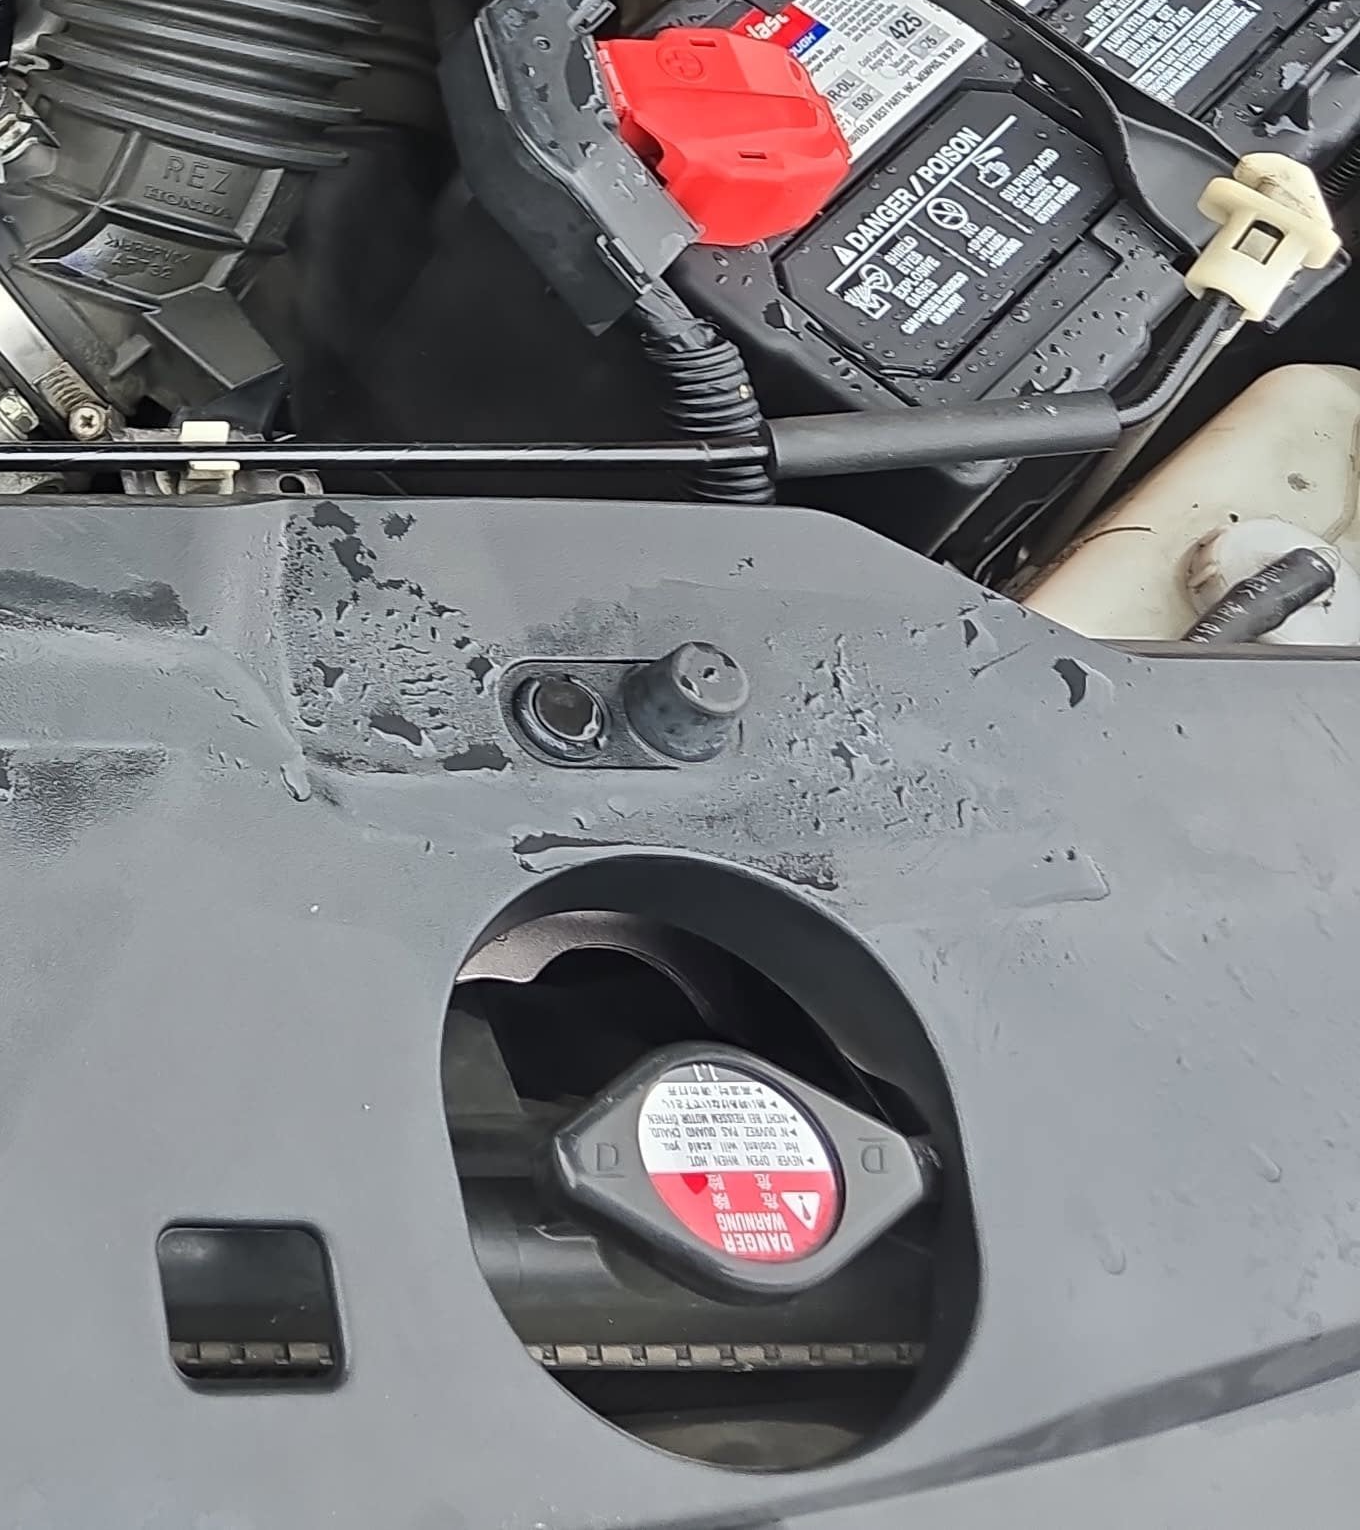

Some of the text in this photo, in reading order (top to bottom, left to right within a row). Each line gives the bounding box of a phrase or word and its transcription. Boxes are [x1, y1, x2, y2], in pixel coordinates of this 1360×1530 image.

[884, 10, 925, 42] 425
[1100, 26, 1131, 52] FLUSH
[1121, 11, 1148, 33] EYES
[1114, 37, 1140, 59] WITH
[1154, 3, 1177, 22] GET
[1126, 5, 1196, 68] MEDICAL HELP FAST
[850, 91, 875, 111] 530
[870, 105, 891, 121] BEST
[884, 89, 909, 109] PARTS,
[163, 155, 232, 195] REZ
[997, 146, 1060, 202] SULFURIC ACID
[144, 184, 233, 219] HONDA
[958, 221, 981, 238] NO
[880, 234, 920, 266] SHIELD
[893, 250, 926, 275] EYES
[888, 255, 943, 299] EXPLOSIVE
[902, 278, 940, 308] GASES
[680, 1113, 708, 1123] MOTOR
[710, 1113, 745, 1123] HEISSEN
[747, 1113, 761, 1123] BEI
[763, 1113, 788, 1123] NICHT
[684, 1127, 716, 1136] QUAND
[720, 1127, 737, 1136] PAS
[687, 1141, 712, 1151] scald
[720, 1141, 737, 1151] will
[743, 1141, 776, 1151] coolant
[783, 1142, 799, 1151] Hot
[685, 1155, 803, 1165] NEVER OPEN WHEN HOT.
[714, 1212, 787, 1231] WARNUNG
[720, 1232, 795, 1252] DANGER
